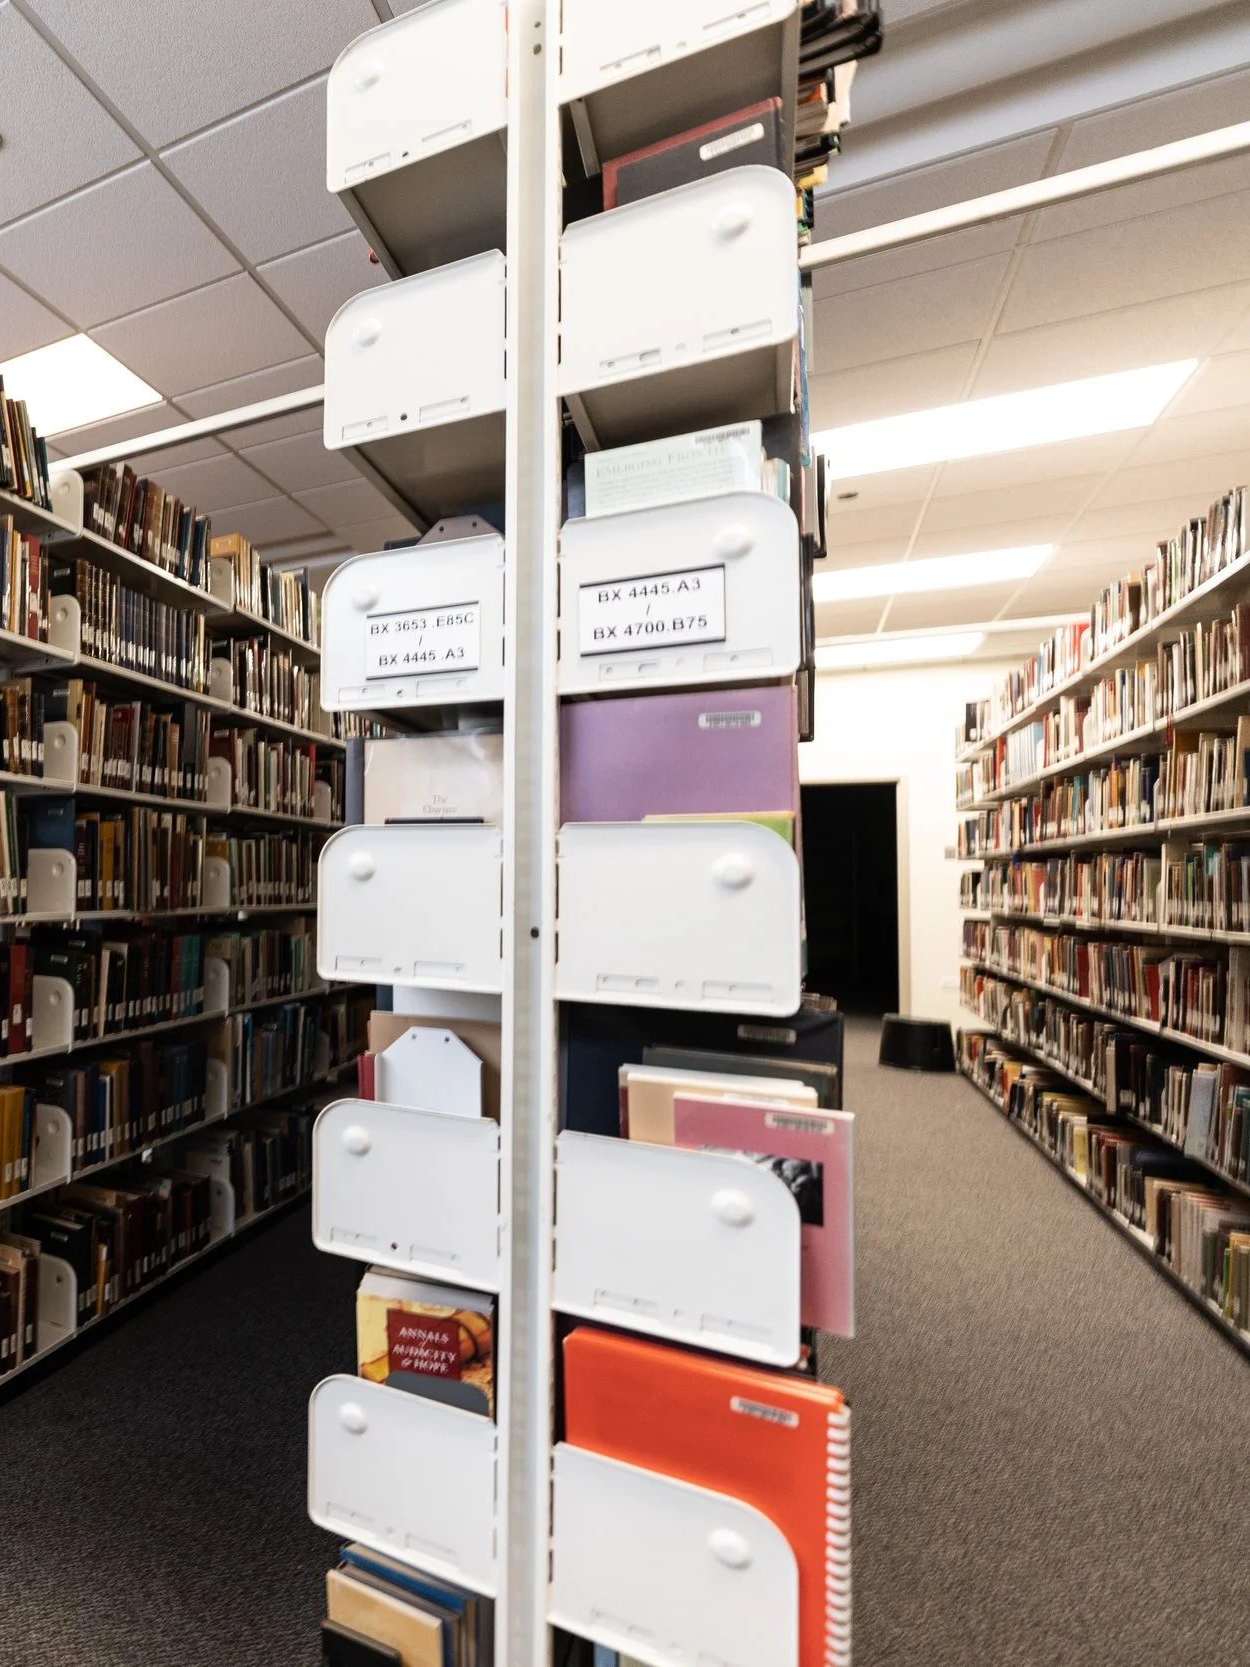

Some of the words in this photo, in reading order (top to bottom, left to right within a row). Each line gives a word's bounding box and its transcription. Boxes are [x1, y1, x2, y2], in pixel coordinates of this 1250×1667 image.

[598, 588, 622, 603] BX
[628, 577, 701, 598] 4445.A3
[370, 622, 390, 635] BX
[395, 618, 427, 632] 3653
[593, 626, 617, 640] BX
[624, 615, 708, 636] 4700.B75
[379, 653, 398, 666] BX
[403, 649, 436, 664] 4445
[398, 1326, 450, 1344] ANNALS
[392, 1343, 457, 1363] AUDACITY
[413, 1358, 449, 1374] HOPE
